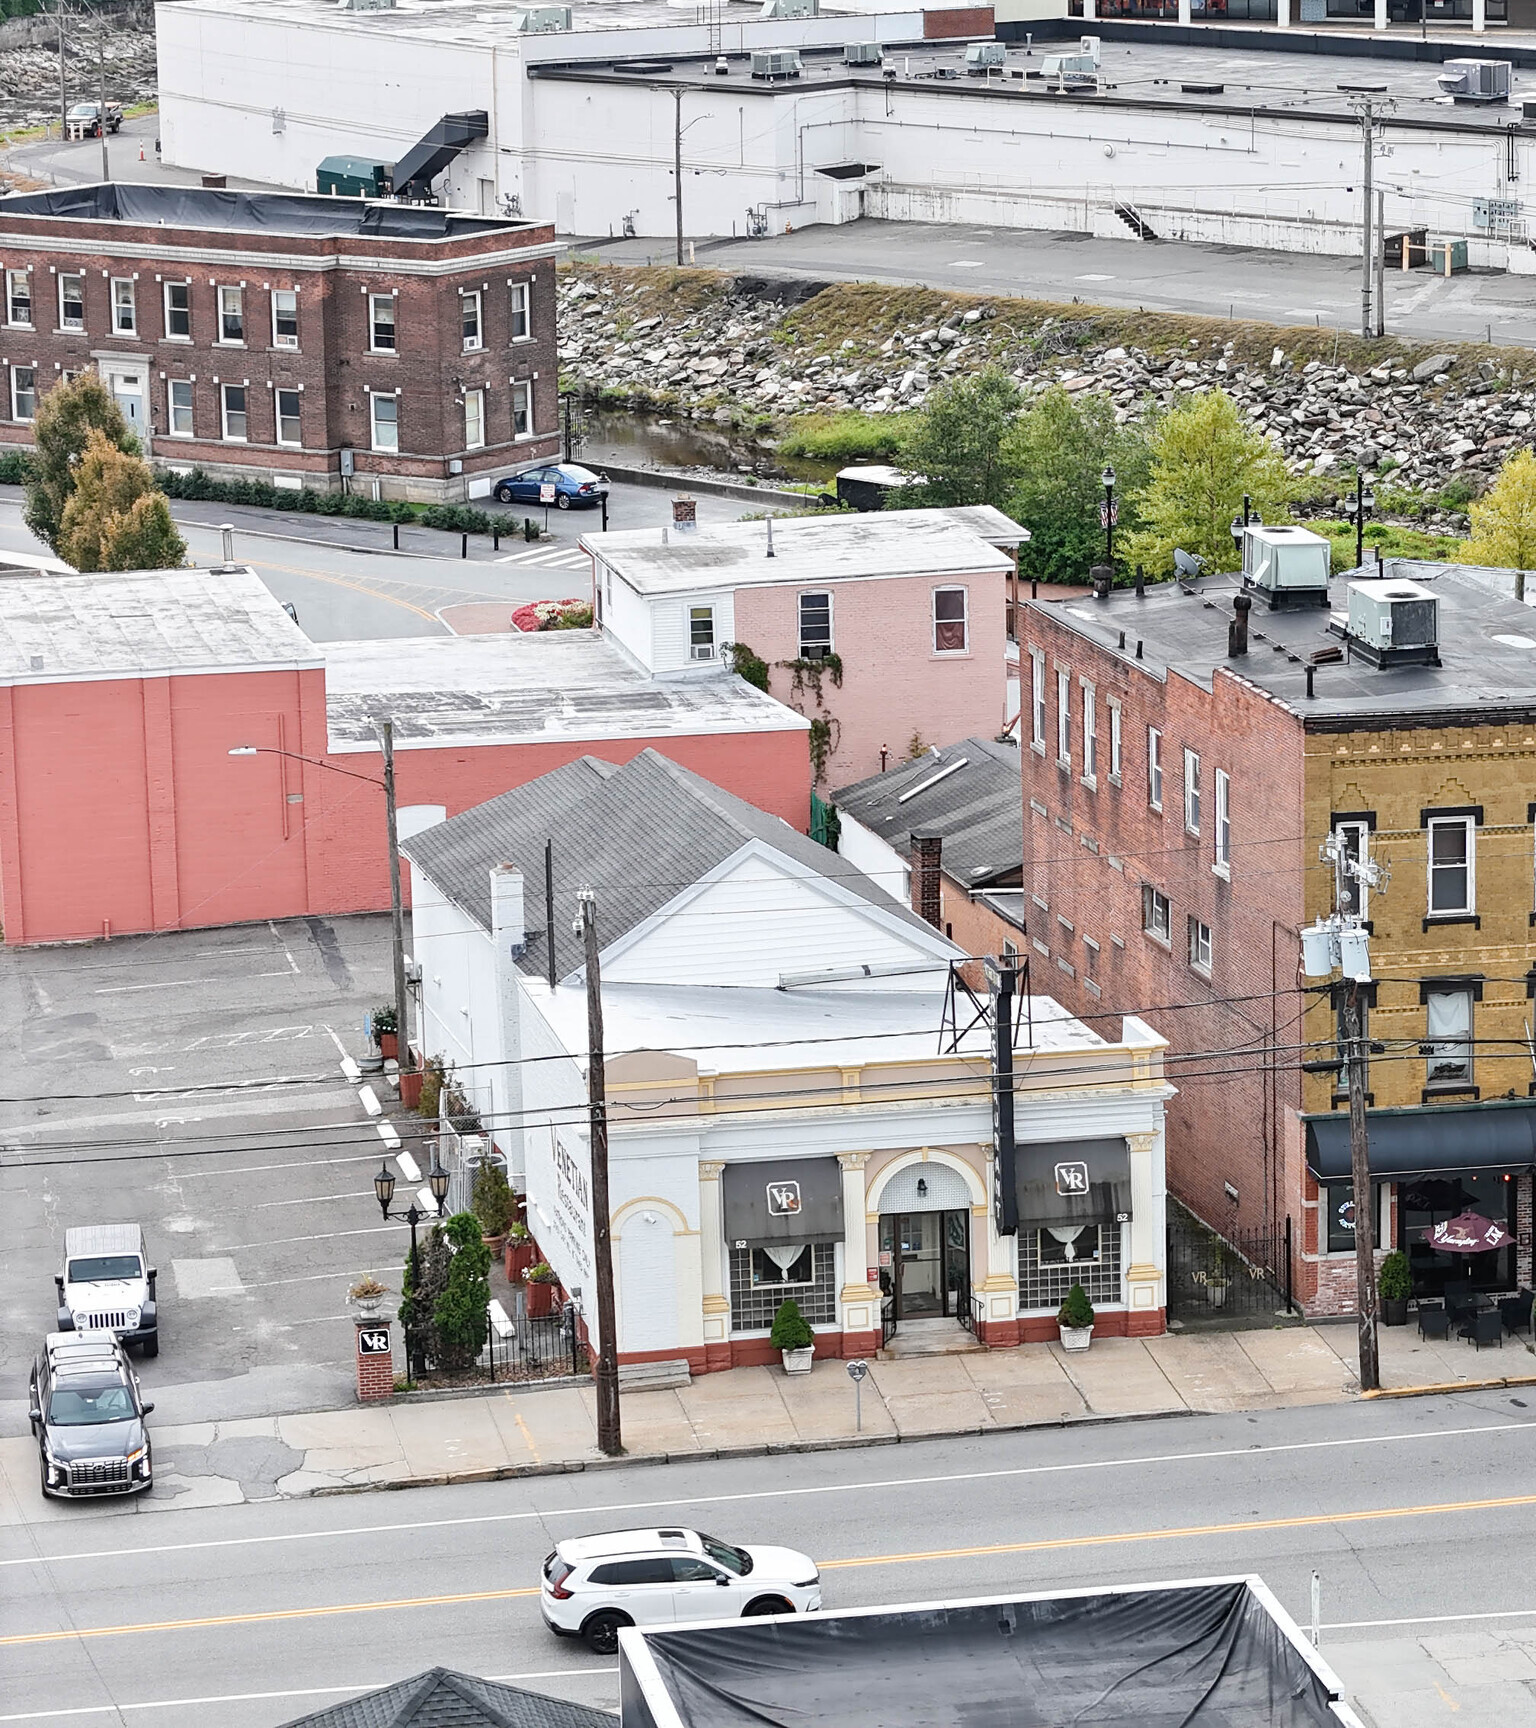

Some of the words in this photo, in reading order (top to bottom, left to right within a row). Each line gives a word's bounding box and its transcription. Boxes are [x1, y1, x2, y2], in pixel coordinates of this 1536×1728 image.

[1059, 1167, 1085, 1189] VR
[1117, 1213, 1128, 1221] 52
[735, 1240, 747, 1249] 52
[1191, 1271, 1207, 1284] VR
[1249, 1267, 1266, 1280] VR
[362, 1332, 388, 1350] VR
